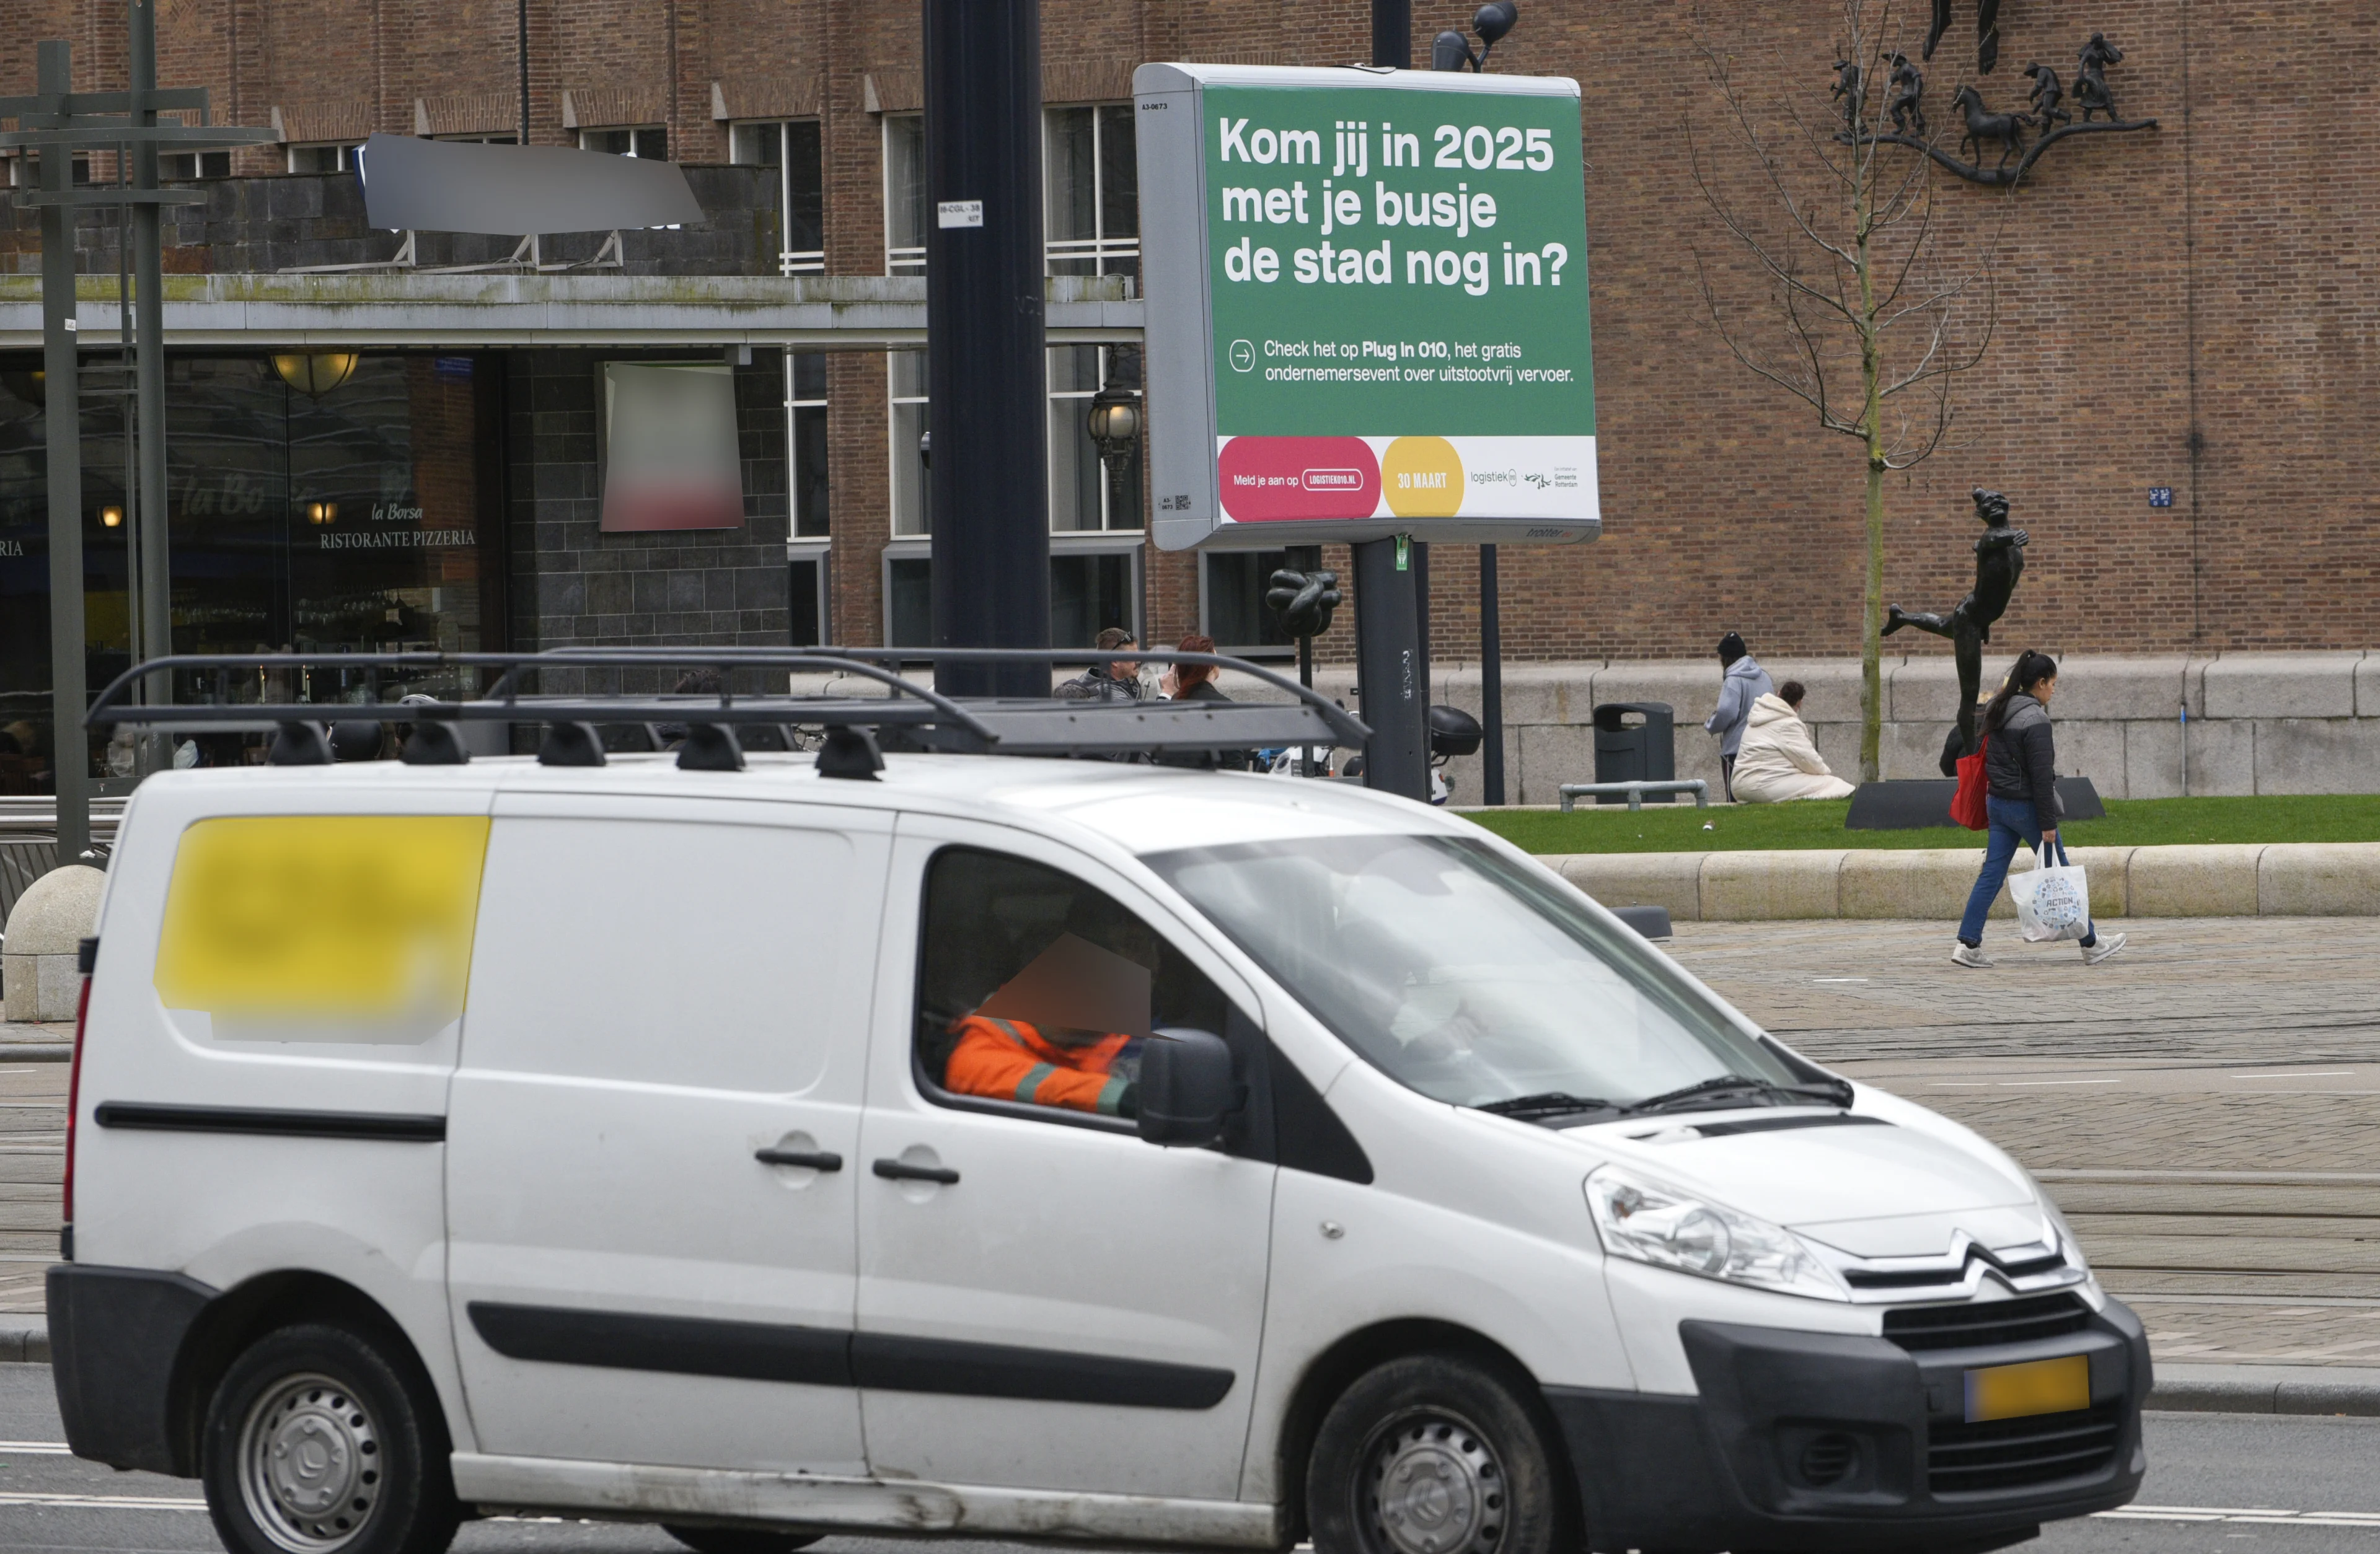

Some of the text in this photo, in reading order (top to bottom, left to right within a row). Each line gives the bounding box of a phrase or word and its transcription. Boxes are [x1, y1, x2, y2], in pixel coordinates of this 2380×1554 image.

[1220, 117, 1554, 177] Kom jij in 2025
[1222, 179, 1497, 238] met je busje
[1224, 237, 1568, 296] de stad nog in?
[1264, 340, 1522, 362] Check het op Plug In 010, het gratis
[1265, 364, 1574, 385] ondernemersevent over uitstootvrij vervoer.
[1233, 475, 1356, 488] Meld je aan op LOGISTIEK010.NL
[1398, 472, 1447, 489] 30 MAART
[1471, 472, 1508, 485] logistiek
[371, 503, 423, 520] la Borsa
[320, 530, 476, 549] RISTORANTE PIZZERIA
[2046, 897, 2073, 908] ACTION
